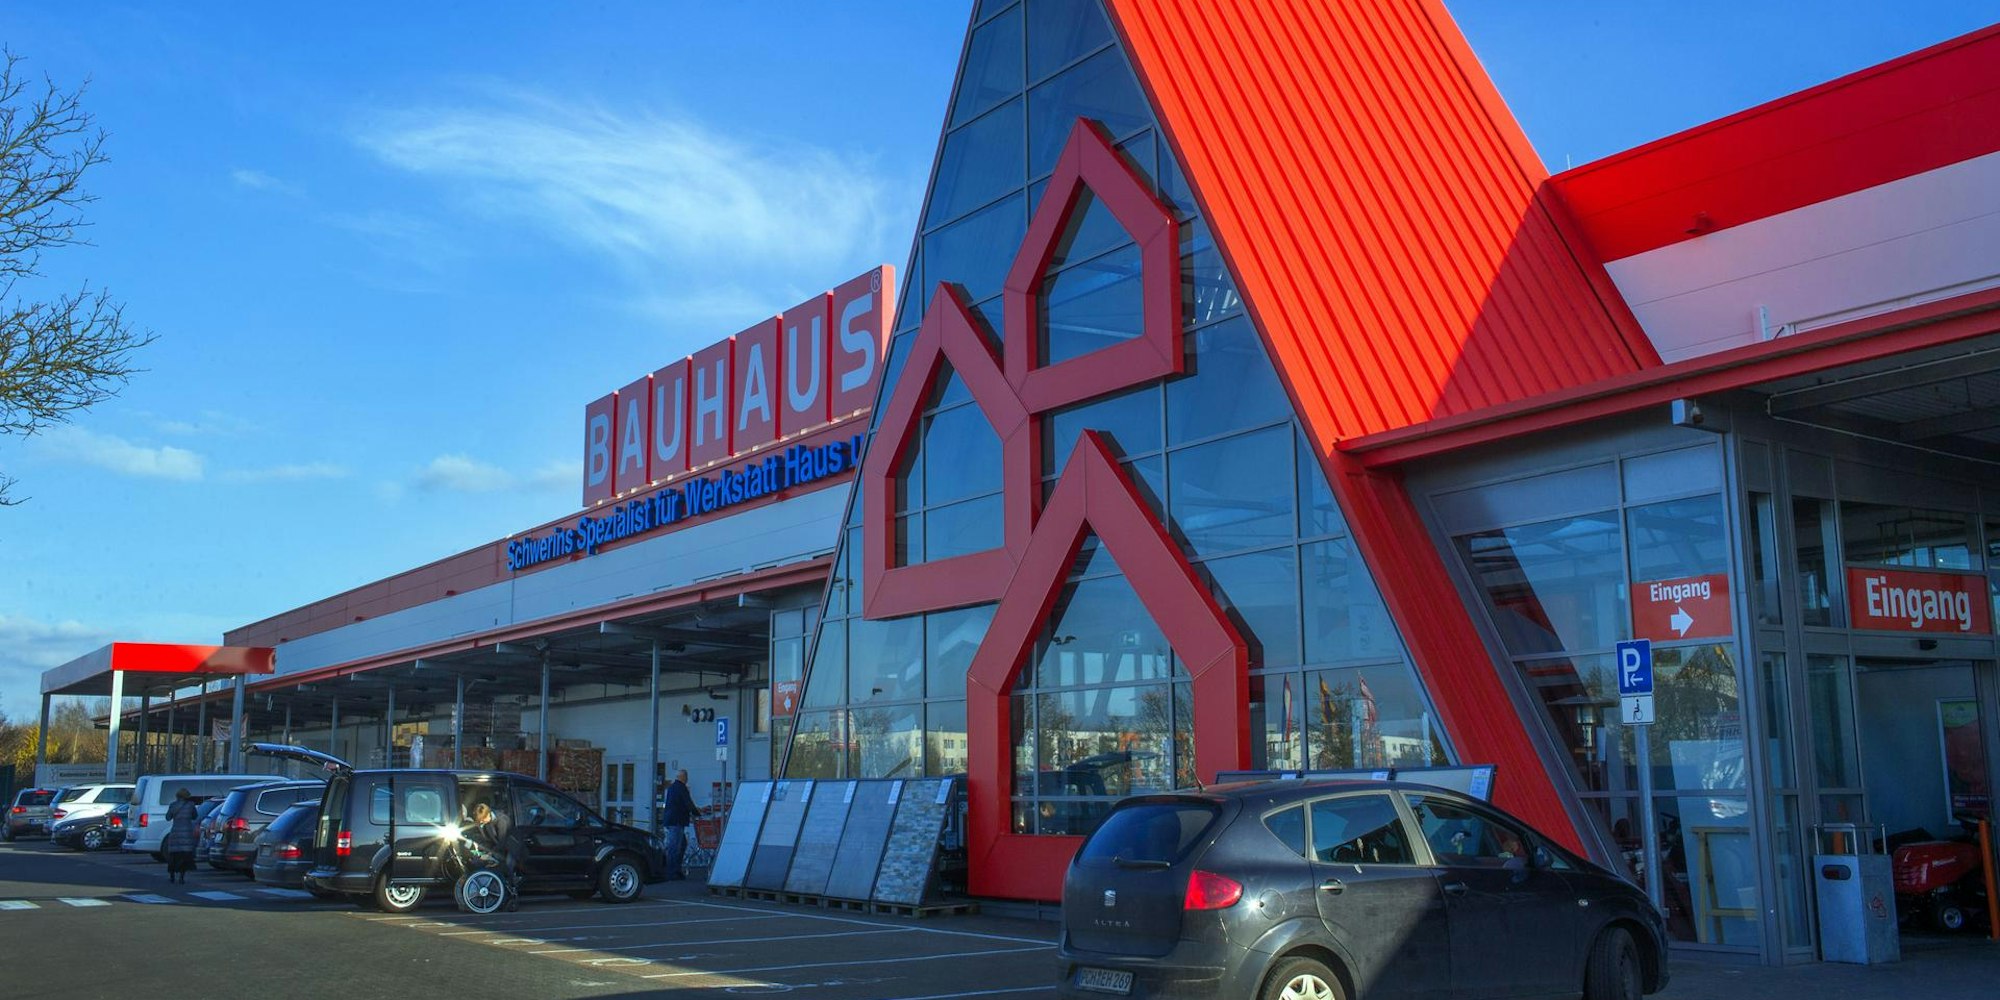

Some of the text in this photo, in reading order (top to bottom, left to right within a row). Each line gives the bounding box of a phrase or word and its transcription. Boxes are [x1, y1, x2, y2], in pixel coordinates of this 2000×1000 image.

[588, 292, 875, 488] BAUHAUS
[506, 526, 575, 571] Schwerins
[577, 497, 652, 554] Spezialist
[655, 488, 679, 527] für
[684, 456, 778, 518] Werkstatt
[785, 441, 843, 488] Haus
[1650, 580, 1710, 603] Eingang
[1866, 576, 1972, 631] Eingang
[1622, 648, 1641, 688] P
[1113, 973, 1131, 989] 269
